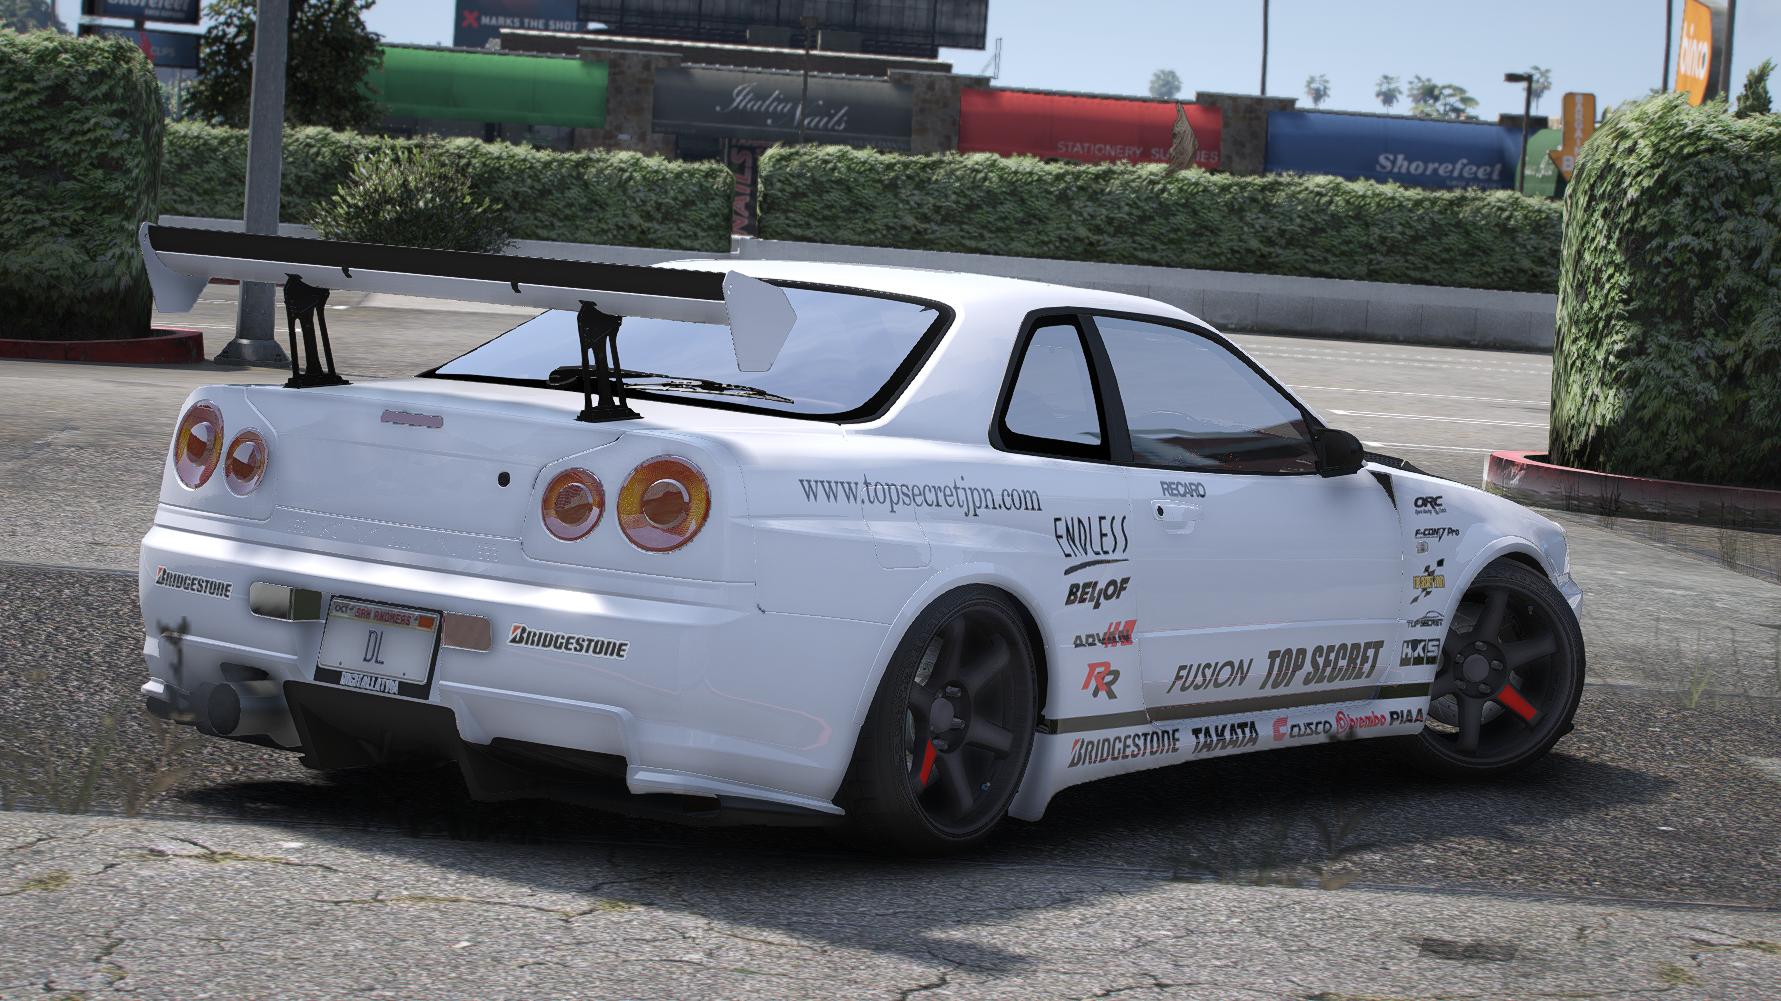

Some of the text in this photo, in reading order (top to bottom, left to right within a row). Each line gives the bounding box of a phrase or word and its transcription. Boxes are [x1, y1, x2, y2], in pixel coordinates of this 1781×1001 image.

[481, 15, 520, 28] MARKS
[523, 19, 545, 30] THE
[548, 20, 578, 32] SHOT
[1681, 21, 1708, 80] binco
[715, 82, 793, 113] Italia
[1057, 141, 1219, 164] STATIONERY SUIES
[1376, 153, 1502, 181] Shorefeet
[731, 147, 754, 236] NAILS
[798, 473, 1042, 517] www.topsecretjpn.com
[1160, 480, 1206, 498] RECARO
[1414, 495, 1443, 509] ORC
[1053, 515, 1128, 558] ENDLESS
[156, 566, 232, 598] BRIDGESTONE
[362, 629, 385, 665] DL
[509, 625, 629, 658] BRIDGESTONE
[1401, 639, 1440, 661] HKS
[1166, 640, 1385, 694] FUSION TOP SECRET
[1067, 728, 1181, 769] BRIDGESTONE
[1191, 719, 1259, 755] TAKATA
[1289, 719, 1332, 739] CUSCO
[1389, 707, 1424, 726] PIAA
